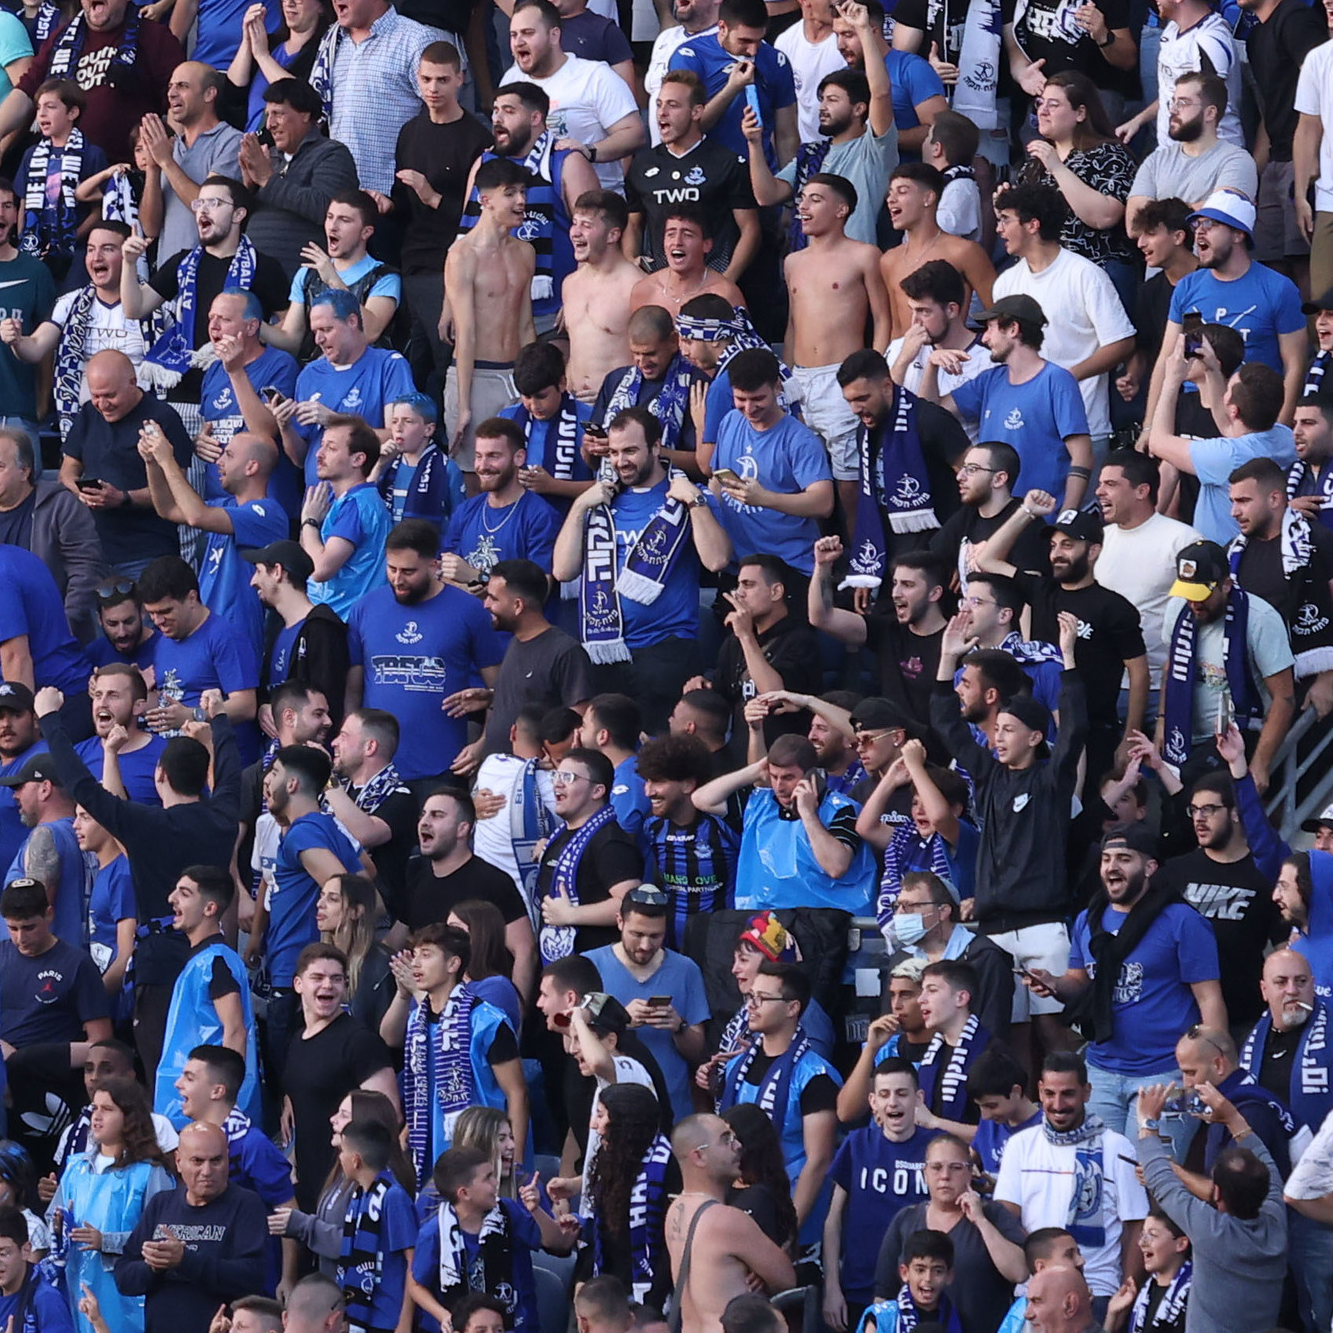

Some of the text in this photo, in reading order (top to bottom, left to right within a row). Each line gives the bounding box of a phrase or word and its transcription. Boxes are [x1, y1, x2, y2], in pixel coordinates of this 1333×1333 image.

[653, 187, 700, 203] TWO
[890, 492, 930, 508] פתח-תקוה
[663, 873, 718, 885] MANGOVE
[38, 969, 63, 983] PARIS
[859, 1168, 928, 1194] ICON
